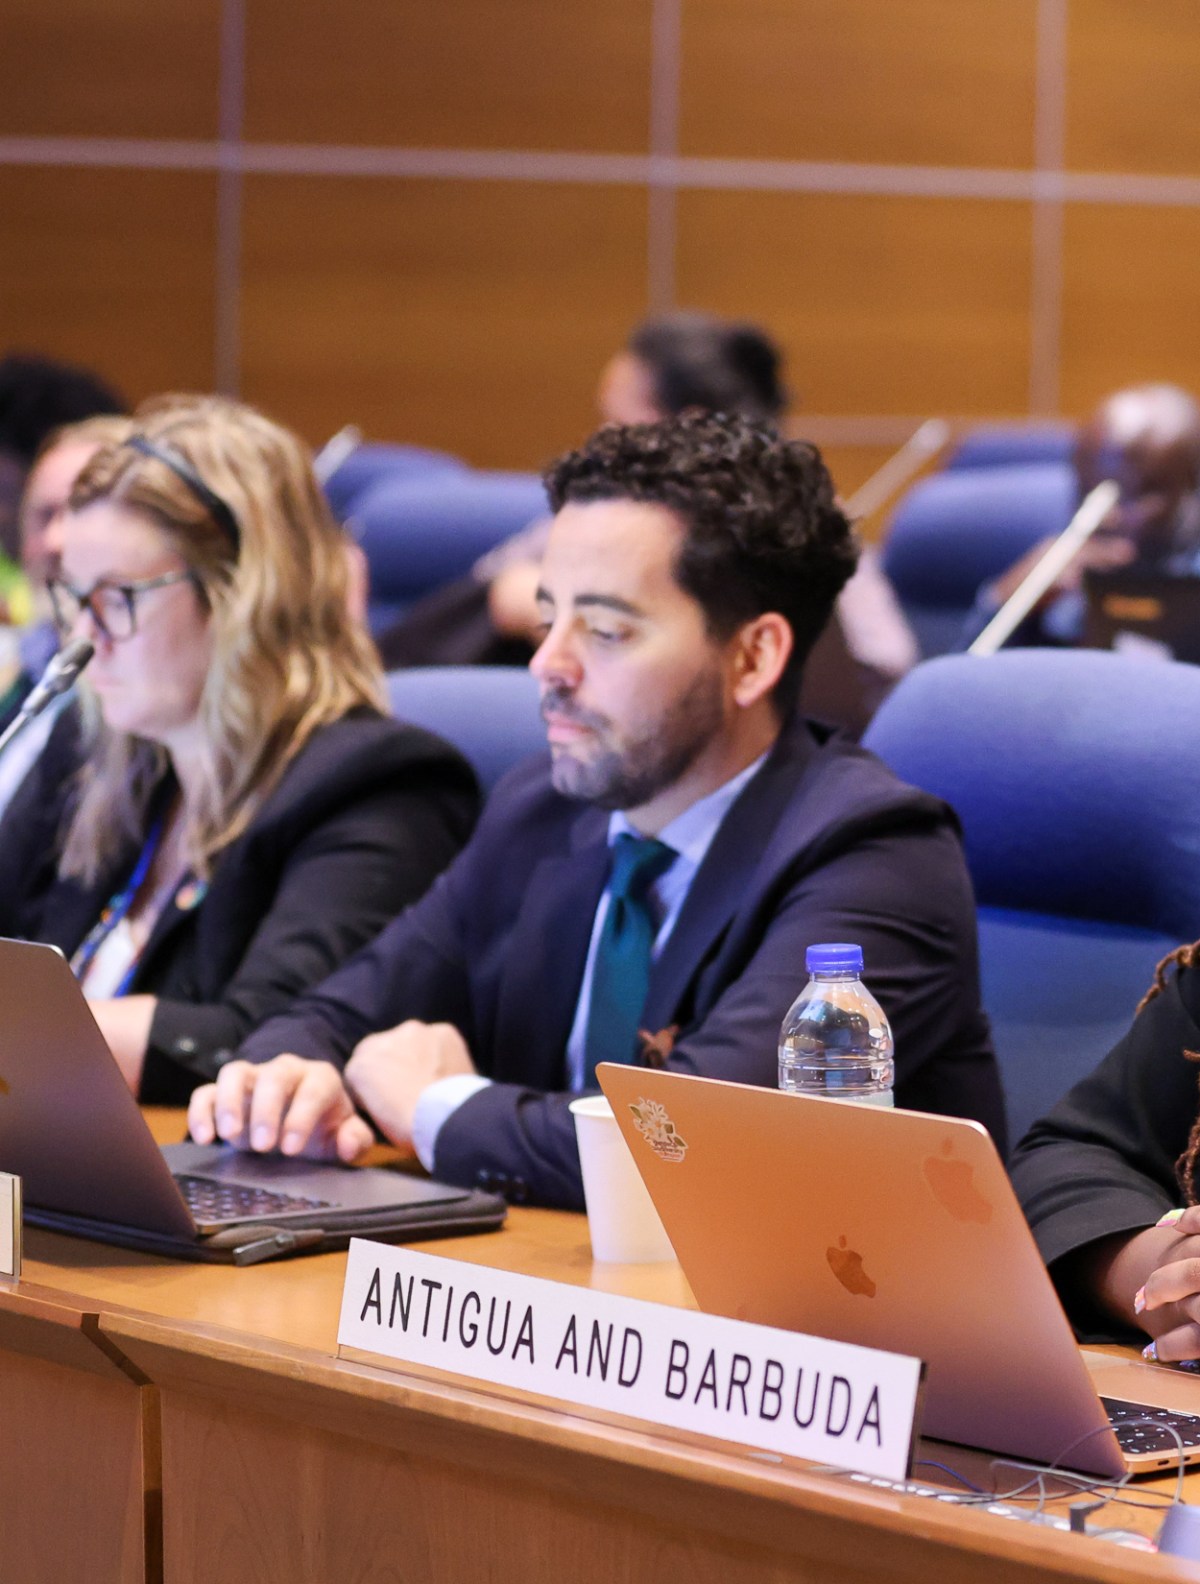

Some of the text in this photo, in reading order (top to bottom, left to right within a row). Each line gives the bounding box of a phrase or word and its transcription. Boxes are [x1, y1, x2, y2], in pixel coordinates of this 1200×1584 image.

[360, 1267, 882, 1446] ANTIGUA AND BARBUDA
